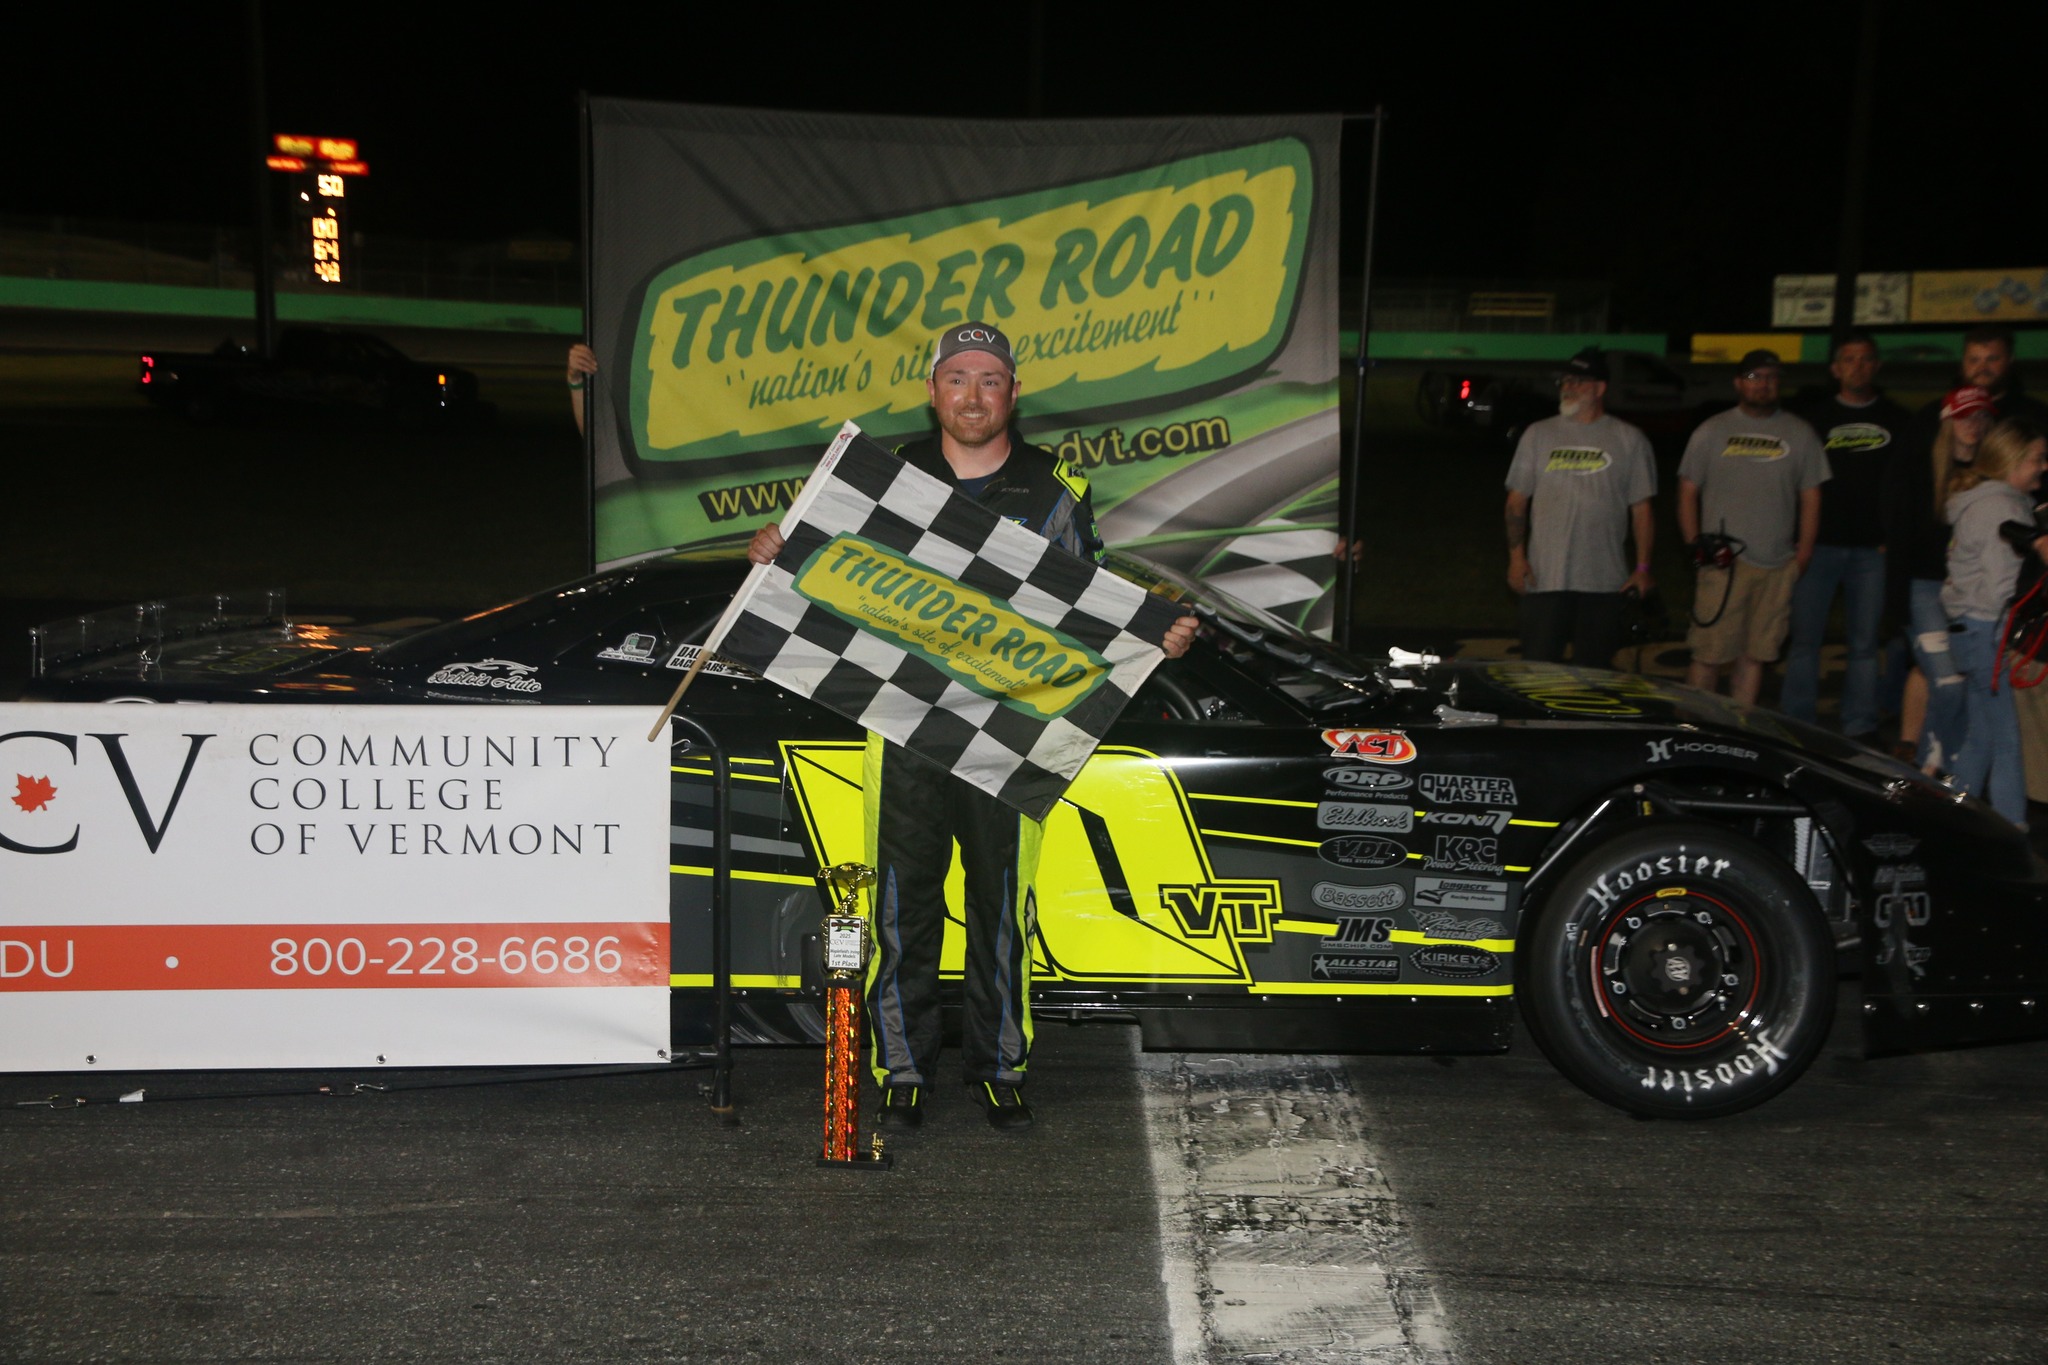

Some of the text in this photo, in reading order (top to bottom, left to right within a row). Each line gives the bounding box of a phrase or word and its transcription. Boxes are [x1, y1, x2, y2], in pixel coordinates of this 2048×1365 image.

[671, 193, 1254, 368] THUNDER ROAD
[957, 328, 996, 344] CCV
[890, 339, 934, 387] sit
[828, 544, 1088, 690] THUNDER ROAD
[911, 625, 938, 649] site
[937, 636, 957, 658] of
[677, 646, 703, 659] DAL
[490, 675, 543, 693] Auto
[249, 732, 621, 768] COMMUNITY
[1336, 734, 1405, 756] ACT
[1674, 742, 1760, 762] HOOSIER
[1335, 770, 1403, 786] DRP
[1419, 774, 1510, 794] QUARTER
[249, 777, 504, 812] COLLEGE
[1325, 789, 1409, 801] Performance Products
[1435, 787, 1515, 804] MASTER
[1323, 806, 1408, 830] Edelbrock
[249, 821, 622, 856] OF VERMONT
[1334, 839, 1393, 859] VDL
[1435, 835, 1498, 864] KRC
[1423, 855, 1505, 876] Power Steering
[1438, 880, 1489, 892] Longacre
[1585, 844, 1732, 916] Hoosier
[1319, 887, 1395, 908] Bassett
[1160, 879, 1284, 945] VT
[1323, 917, 1393, 943] JMS
[1424, 929, 1480, 941] RACECARS
[269, 935, 622, 977] 800-228-6686
[1327, 958, 1399, 969] ALLSTAR
[1420, 952, 1482, 966] KIRKEY
[1639, 1028, 1790, 1105] Hoosier
